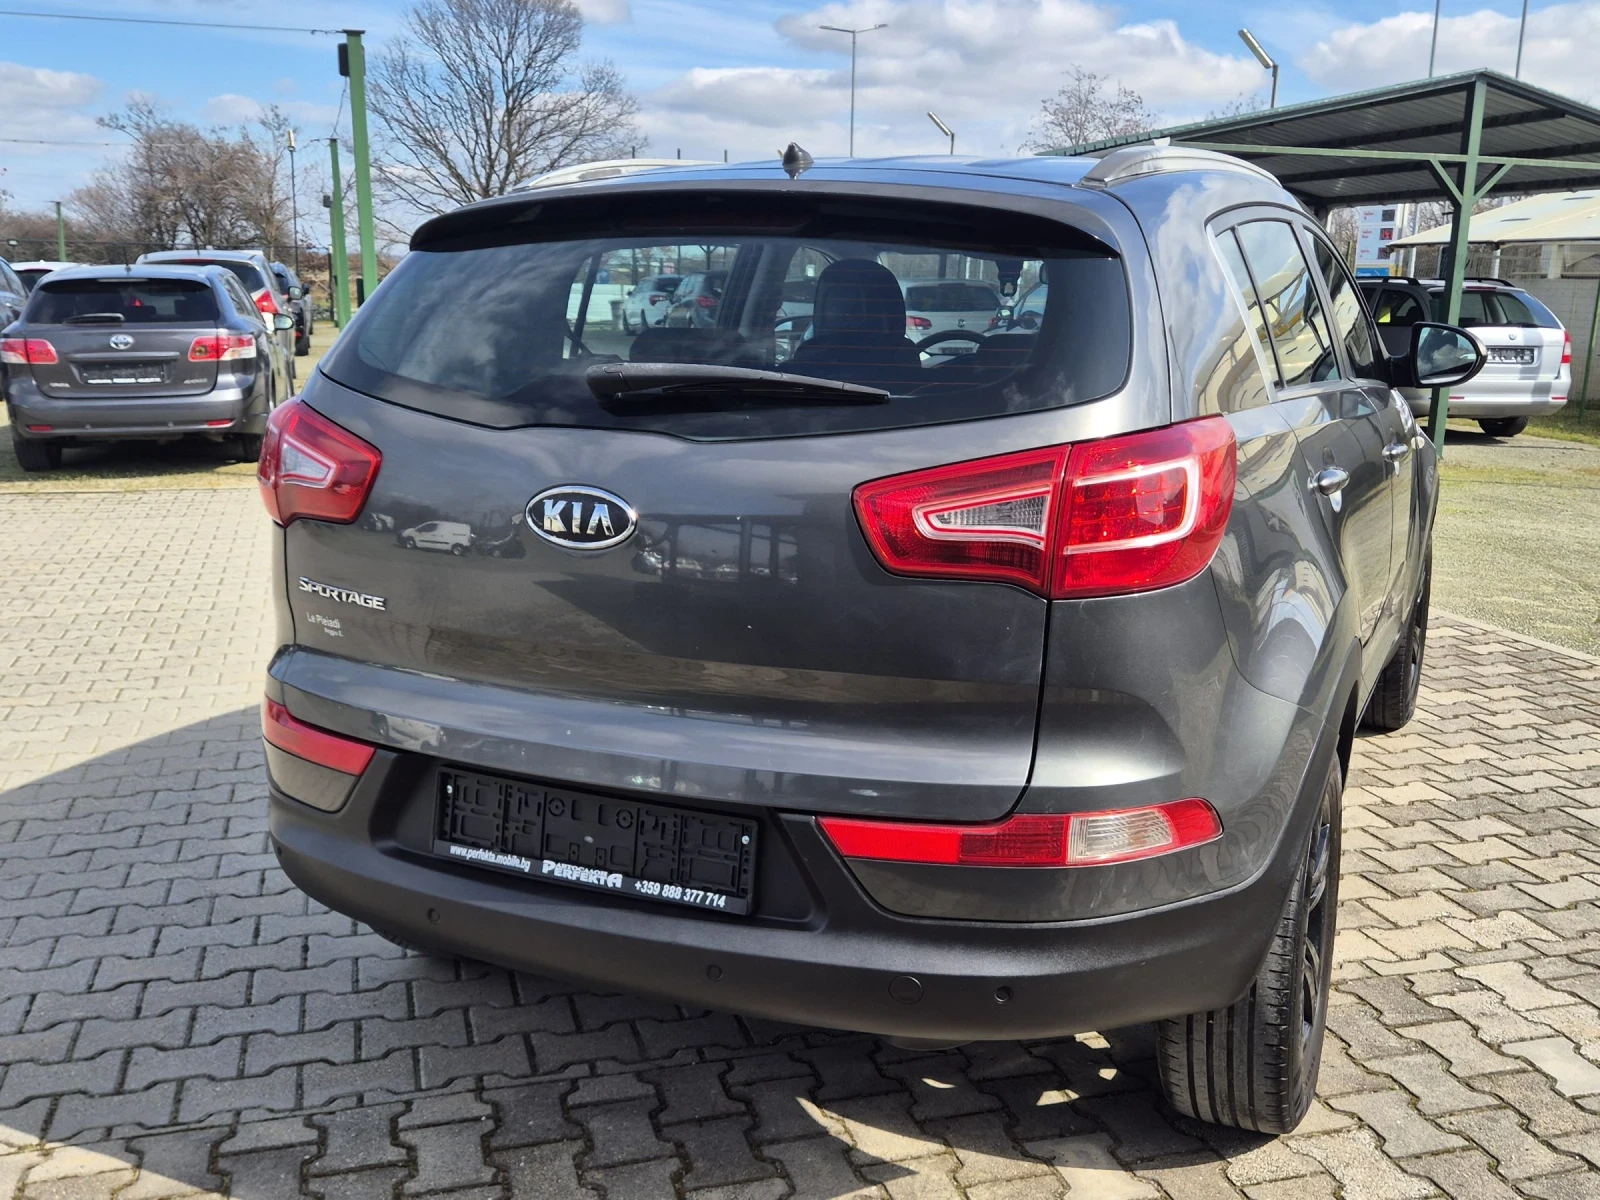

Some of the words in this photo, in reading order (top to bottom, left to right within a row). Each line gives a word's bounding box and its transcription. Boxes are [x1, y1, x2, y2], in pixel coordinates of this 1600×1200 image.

[543, 499, 615, 536] KIA
[299, 576, 386, 611] SPORTAGE
[449, 844, 531, 873] www.perfekta.mobile.bg
[541, 859, 623, 889] PERFEKTA
[634, 880, 661, 896] +359
[661, 884, 683, 900] 888
[683, 888, 705, 904] 377
[705, 892, 727, 909] 714
